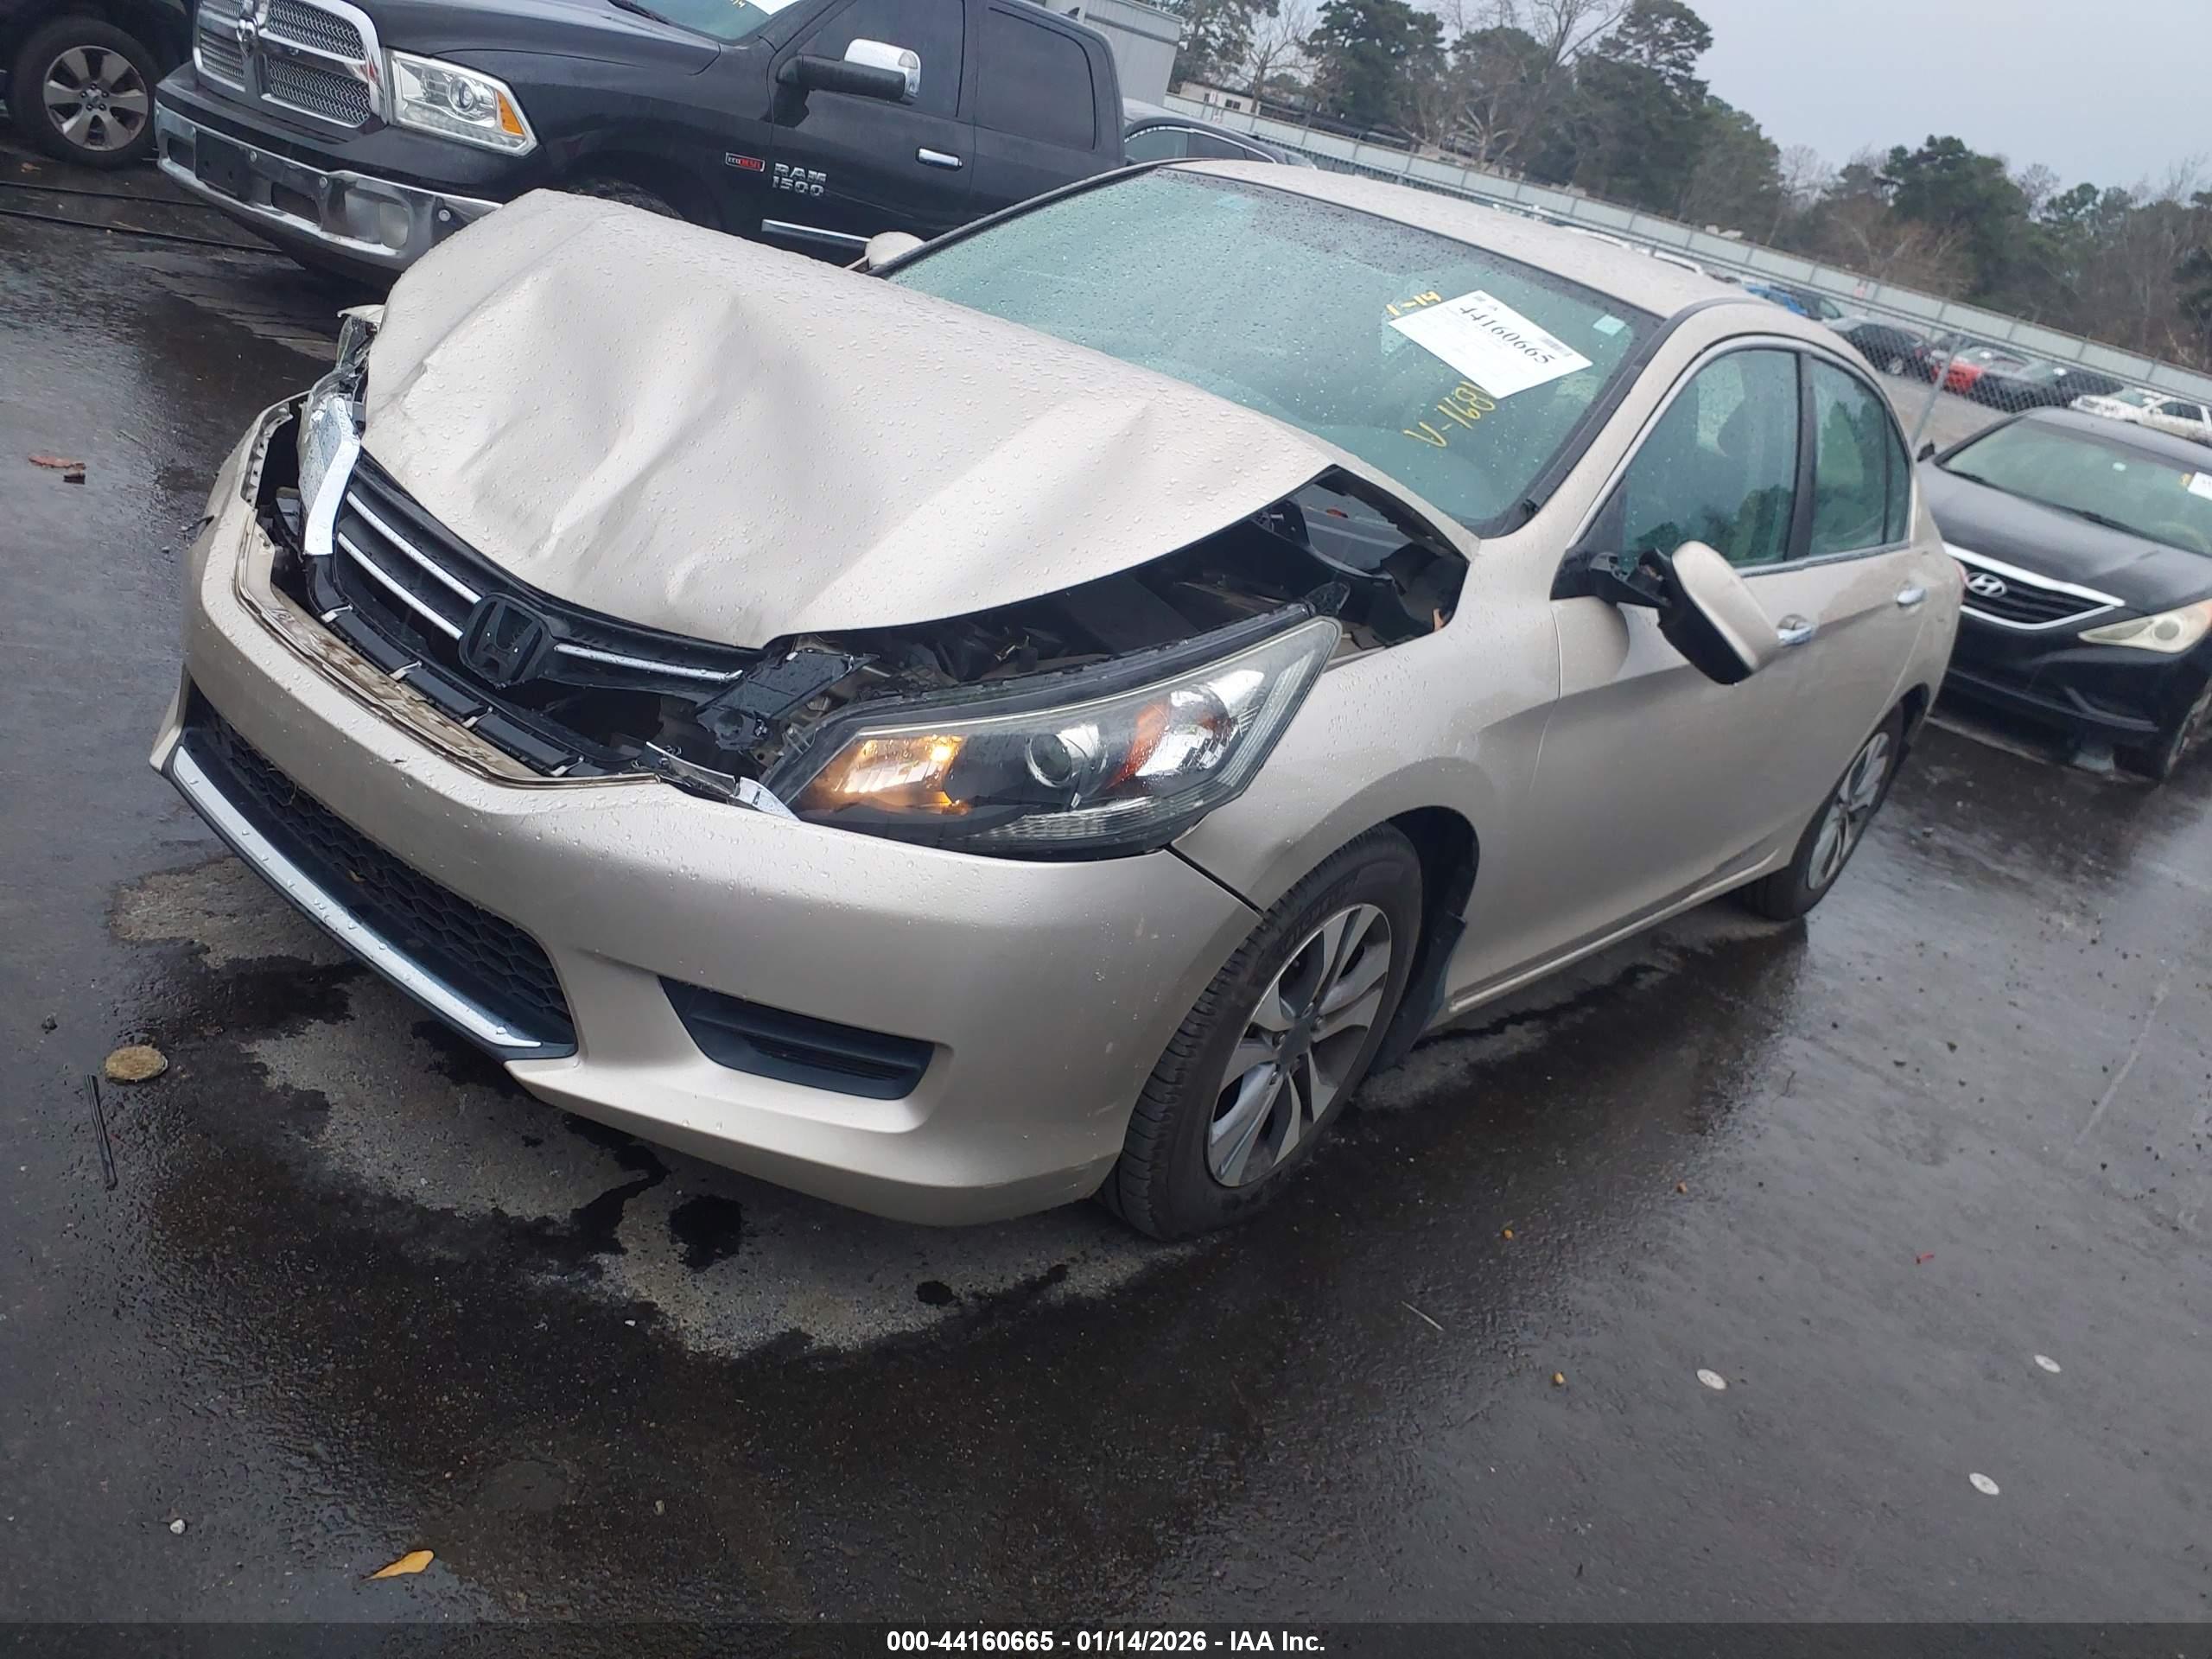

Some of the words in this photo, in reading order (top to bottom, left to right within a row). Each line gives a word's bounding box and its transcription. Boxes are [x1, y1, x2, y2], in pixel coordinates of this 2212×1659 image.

[773, 162, 827, 182] RAM
[772, 175, 825, 197] 1500
[1459, 306, 1556, 364] 44160665
